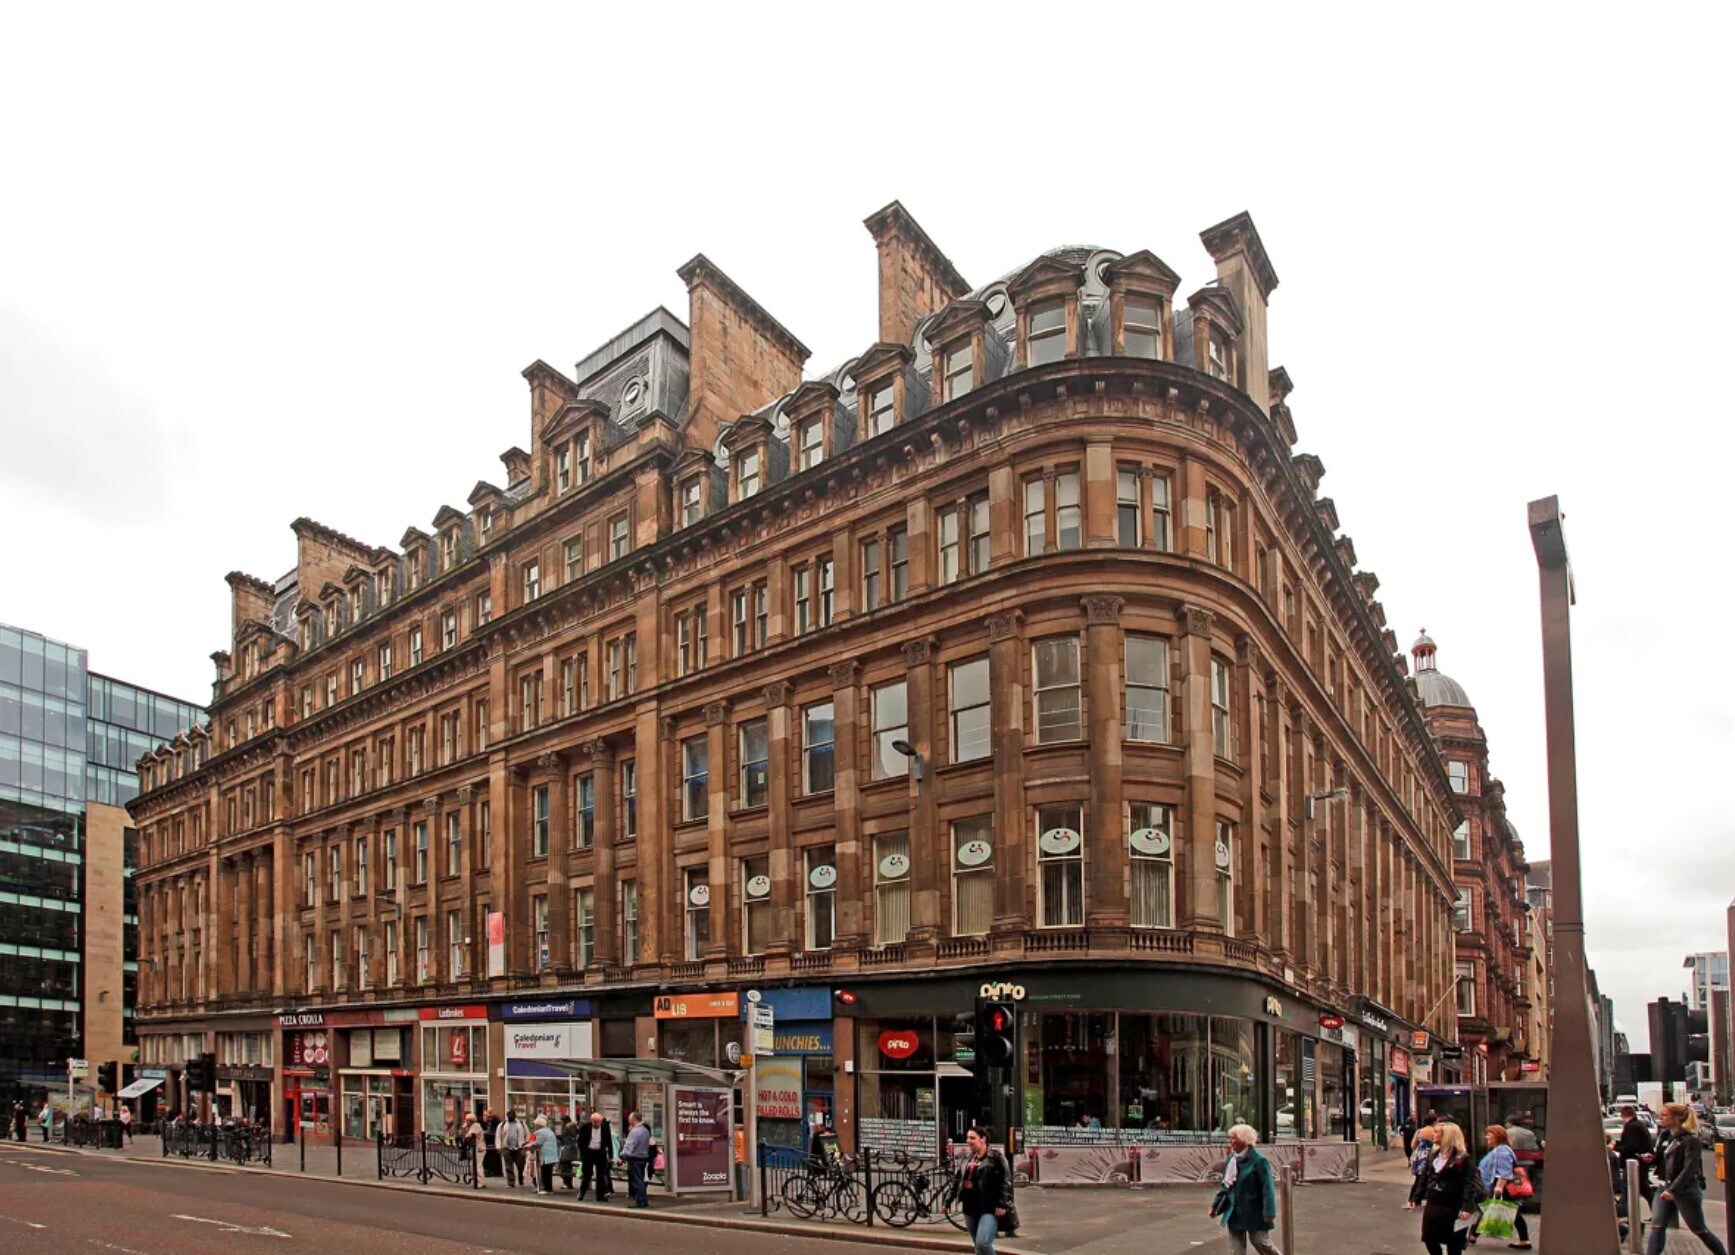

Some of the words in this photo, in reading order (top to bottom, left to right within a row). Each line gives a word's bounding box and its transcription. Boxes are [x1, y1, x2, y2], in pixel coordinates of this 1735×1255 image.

[656, 998, 671, 1011] AD
[671, 1003, 687, 1016] LIB
[438, 1008, 464, 1018] Ladbrokes
[279, 1015, 297, 1025] PIZZA
[298, 1014, 323, 1025] CROLLA
[514, 1033, 555, 1041] Caledonian
[775, 1035, 831, 1050] UNCHIES...
[514, 1041, 537, 1049] Travel
[887, 1038, 909, 1050] pinto
[758, 1090, 771, 1102] HOT
[772, 1091, 777, 1102] &
[780, 1090, 798, 1102] COLD
[679, 1100, 697, 1108] Smart
[757, 1105, 777, 1116] FILLED
[778, 1105, 800, 1117] ROLLS
[703, 1172, 727, 1181] Zoopla
